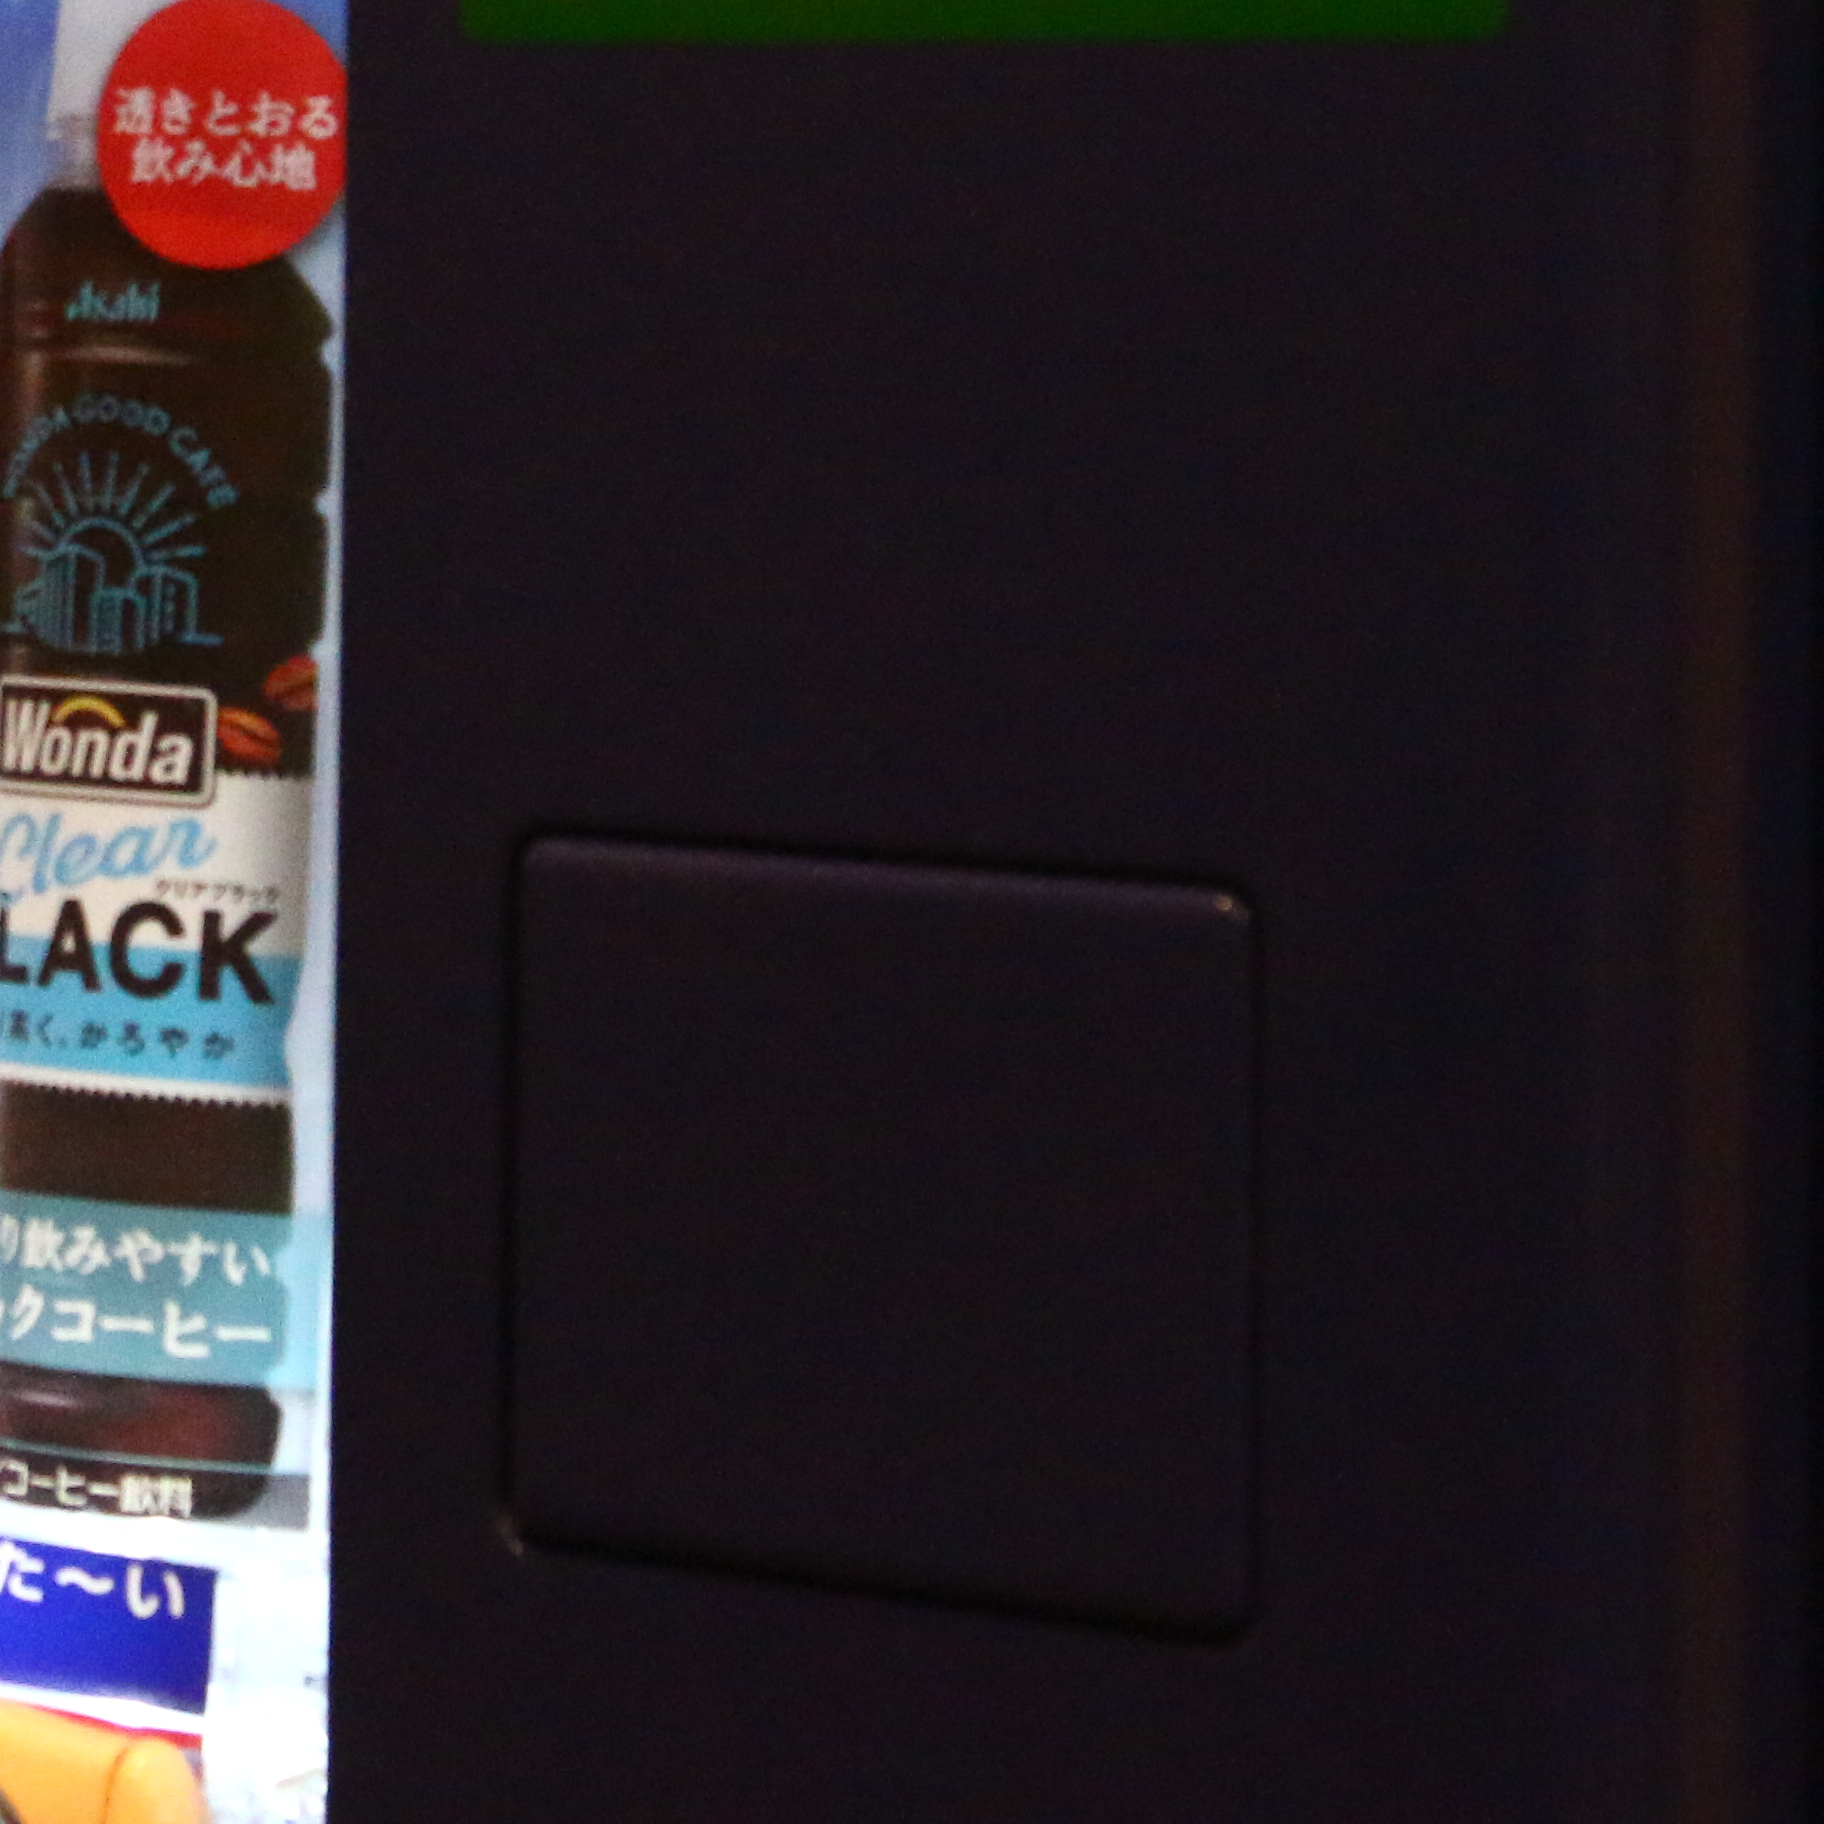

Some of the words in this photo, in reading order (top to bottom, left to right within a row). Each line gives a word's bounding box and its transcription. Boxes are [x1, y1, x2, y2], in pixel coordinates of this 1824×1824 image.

[112, 86, 338, 139] 透きとおる
[129, 136, 318, 191] 飲み心地
[2, 696, 193, 785] Wonda
